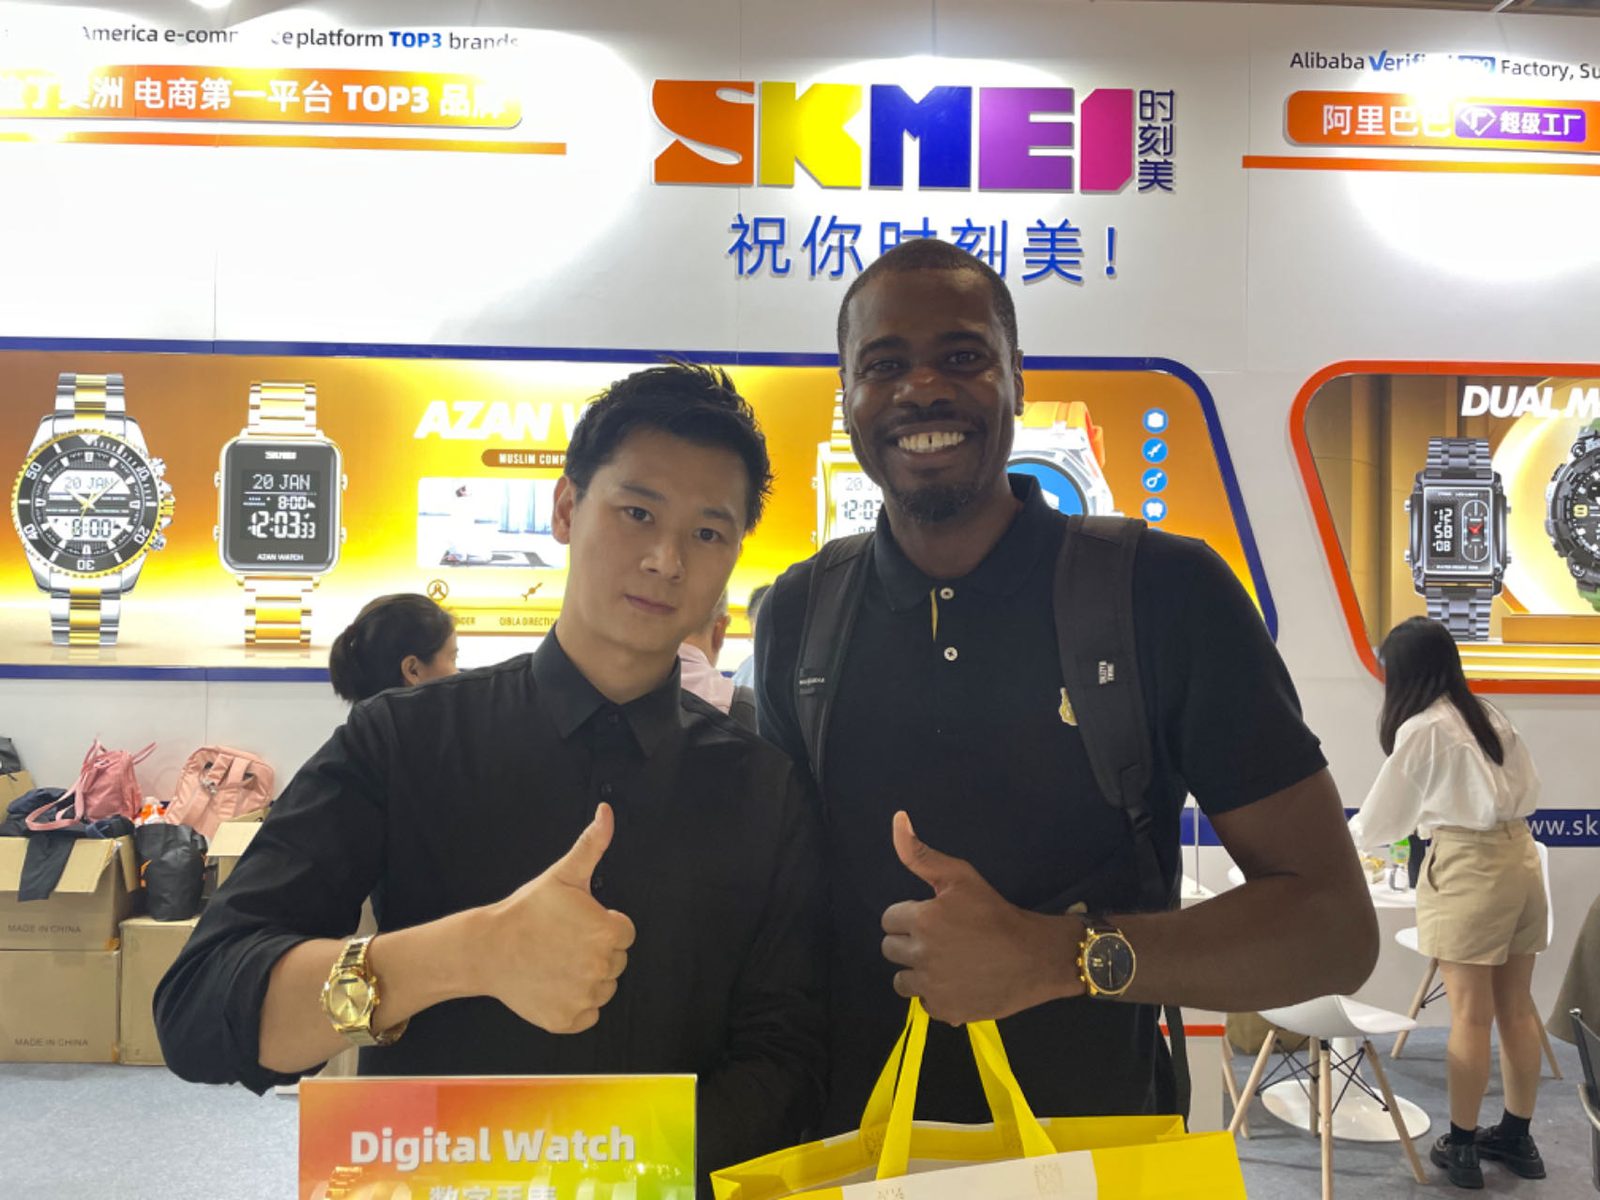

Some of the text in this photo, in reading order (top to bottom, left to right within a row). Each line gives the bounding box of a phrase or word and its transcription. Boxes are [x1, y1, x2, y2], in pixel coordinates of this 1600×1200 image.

[296, 28, 384, 48] platform
[388, 31, 442, 49] TOP3
[1290, 51, 1365, 70] Alibaba
[1501, 60, 1574, 81] Factory,
[134, 76, 333, 114] 电商第一平台
[342, 84, 430, 113] TOP3
[651, 79, 1134, 191] SKMEI
[1323, 105, 1582, 138] 阿里巴巴 超级工厂
[1138, 90, 1175, 192] 时刻美
[1461, 384, 1560, 419] DUAL
[413, 399, 553, 442] AZAN
[499, 453, 536, 465] MUSLIM
[253, 474, 311, 491] 20 JAN
[278, 496, 307, 511] 8:00
[250, 511, 301, 539] 12:03
[351, 1125, 636, 1172] Digital Watch
